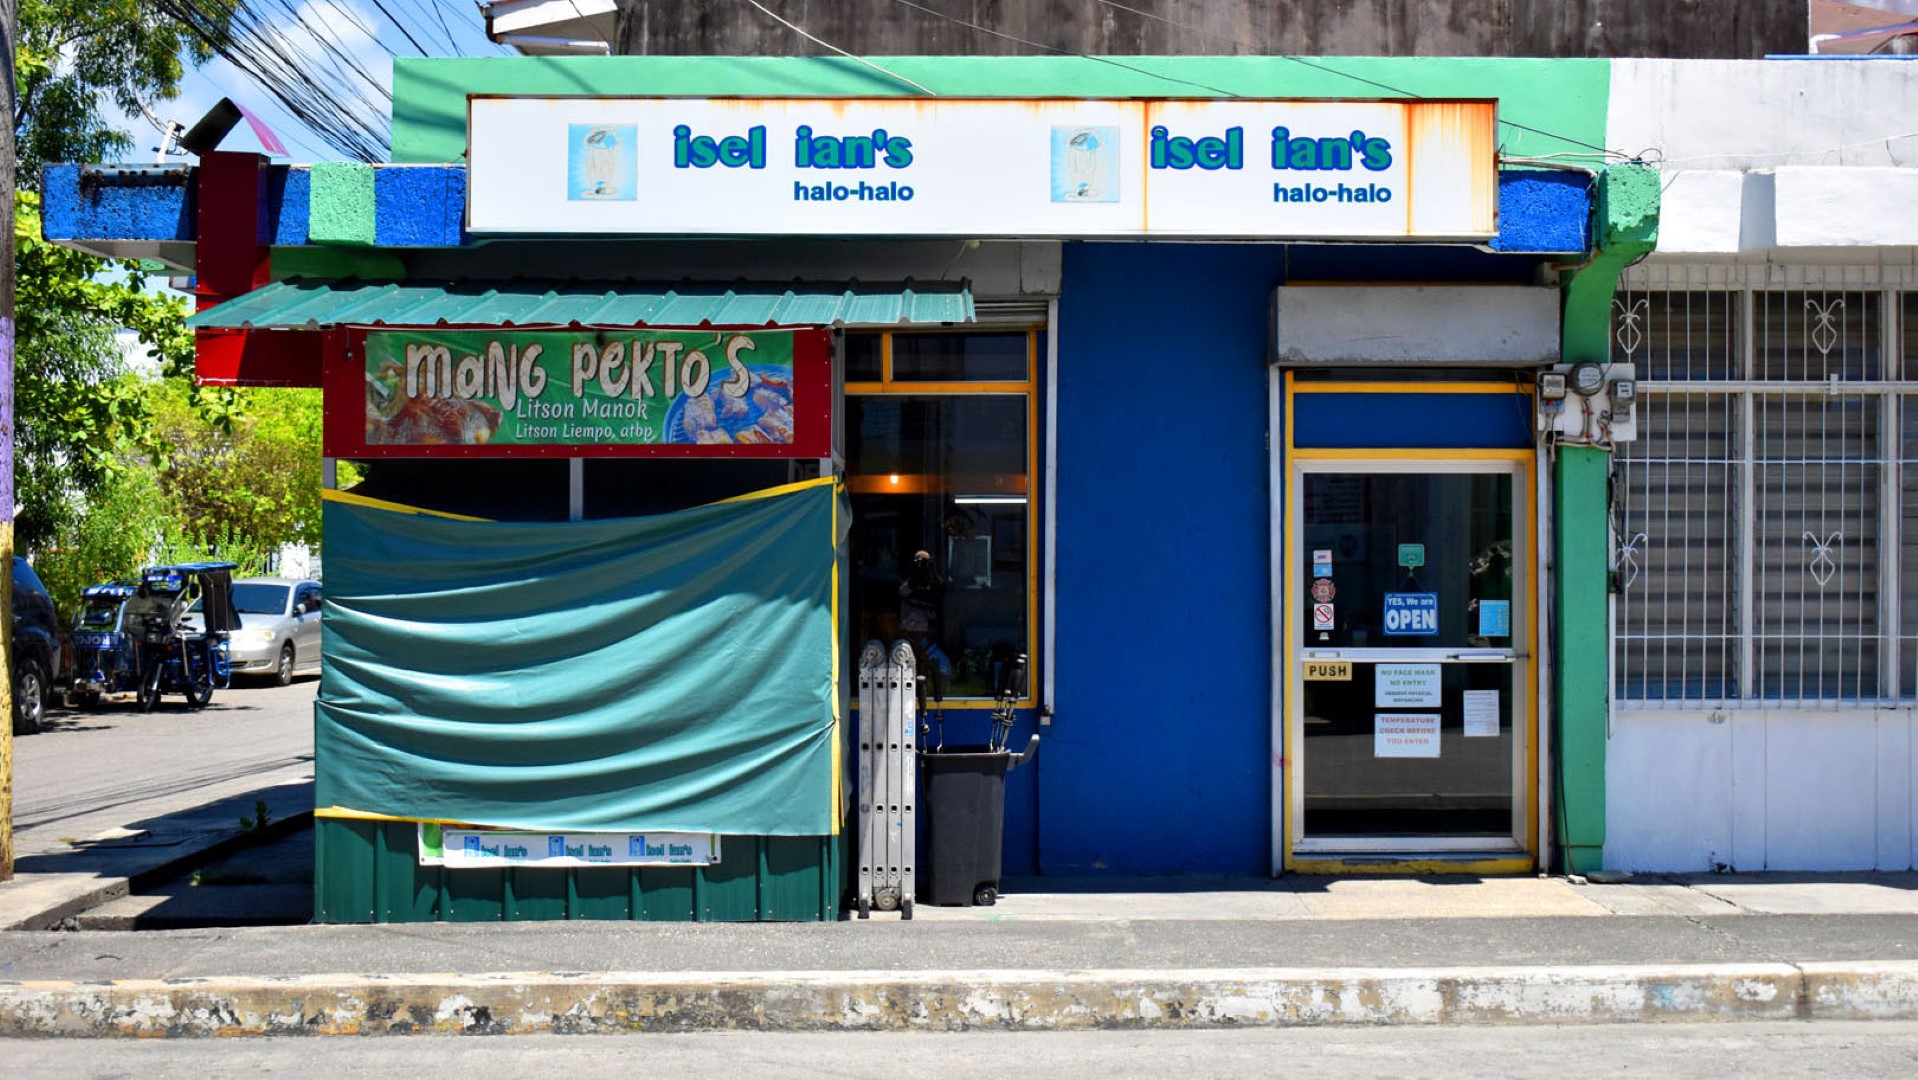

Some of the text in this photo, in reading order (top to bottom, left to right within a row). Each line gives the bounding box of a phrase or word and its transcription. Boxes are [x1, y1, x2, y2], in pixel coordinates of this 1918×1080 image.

[673, 124, 914, 169] isel ian's
[1150, 125, 1393, 171] isel ian's
[793, 181, 915, 201] halo-halo
[1273, 182, 1392, 203] halo-halo
[516, 397, 648, 420] Litson Manok
[515, 423, 653, 441] Litson Liempo, atbp
[1406, 598, 1419, 606] We
[1420, 598, 1433, 606] are
[1386, 609, 1437, 630] OPEN
[1308, 665, 1347, 677] PUSH
